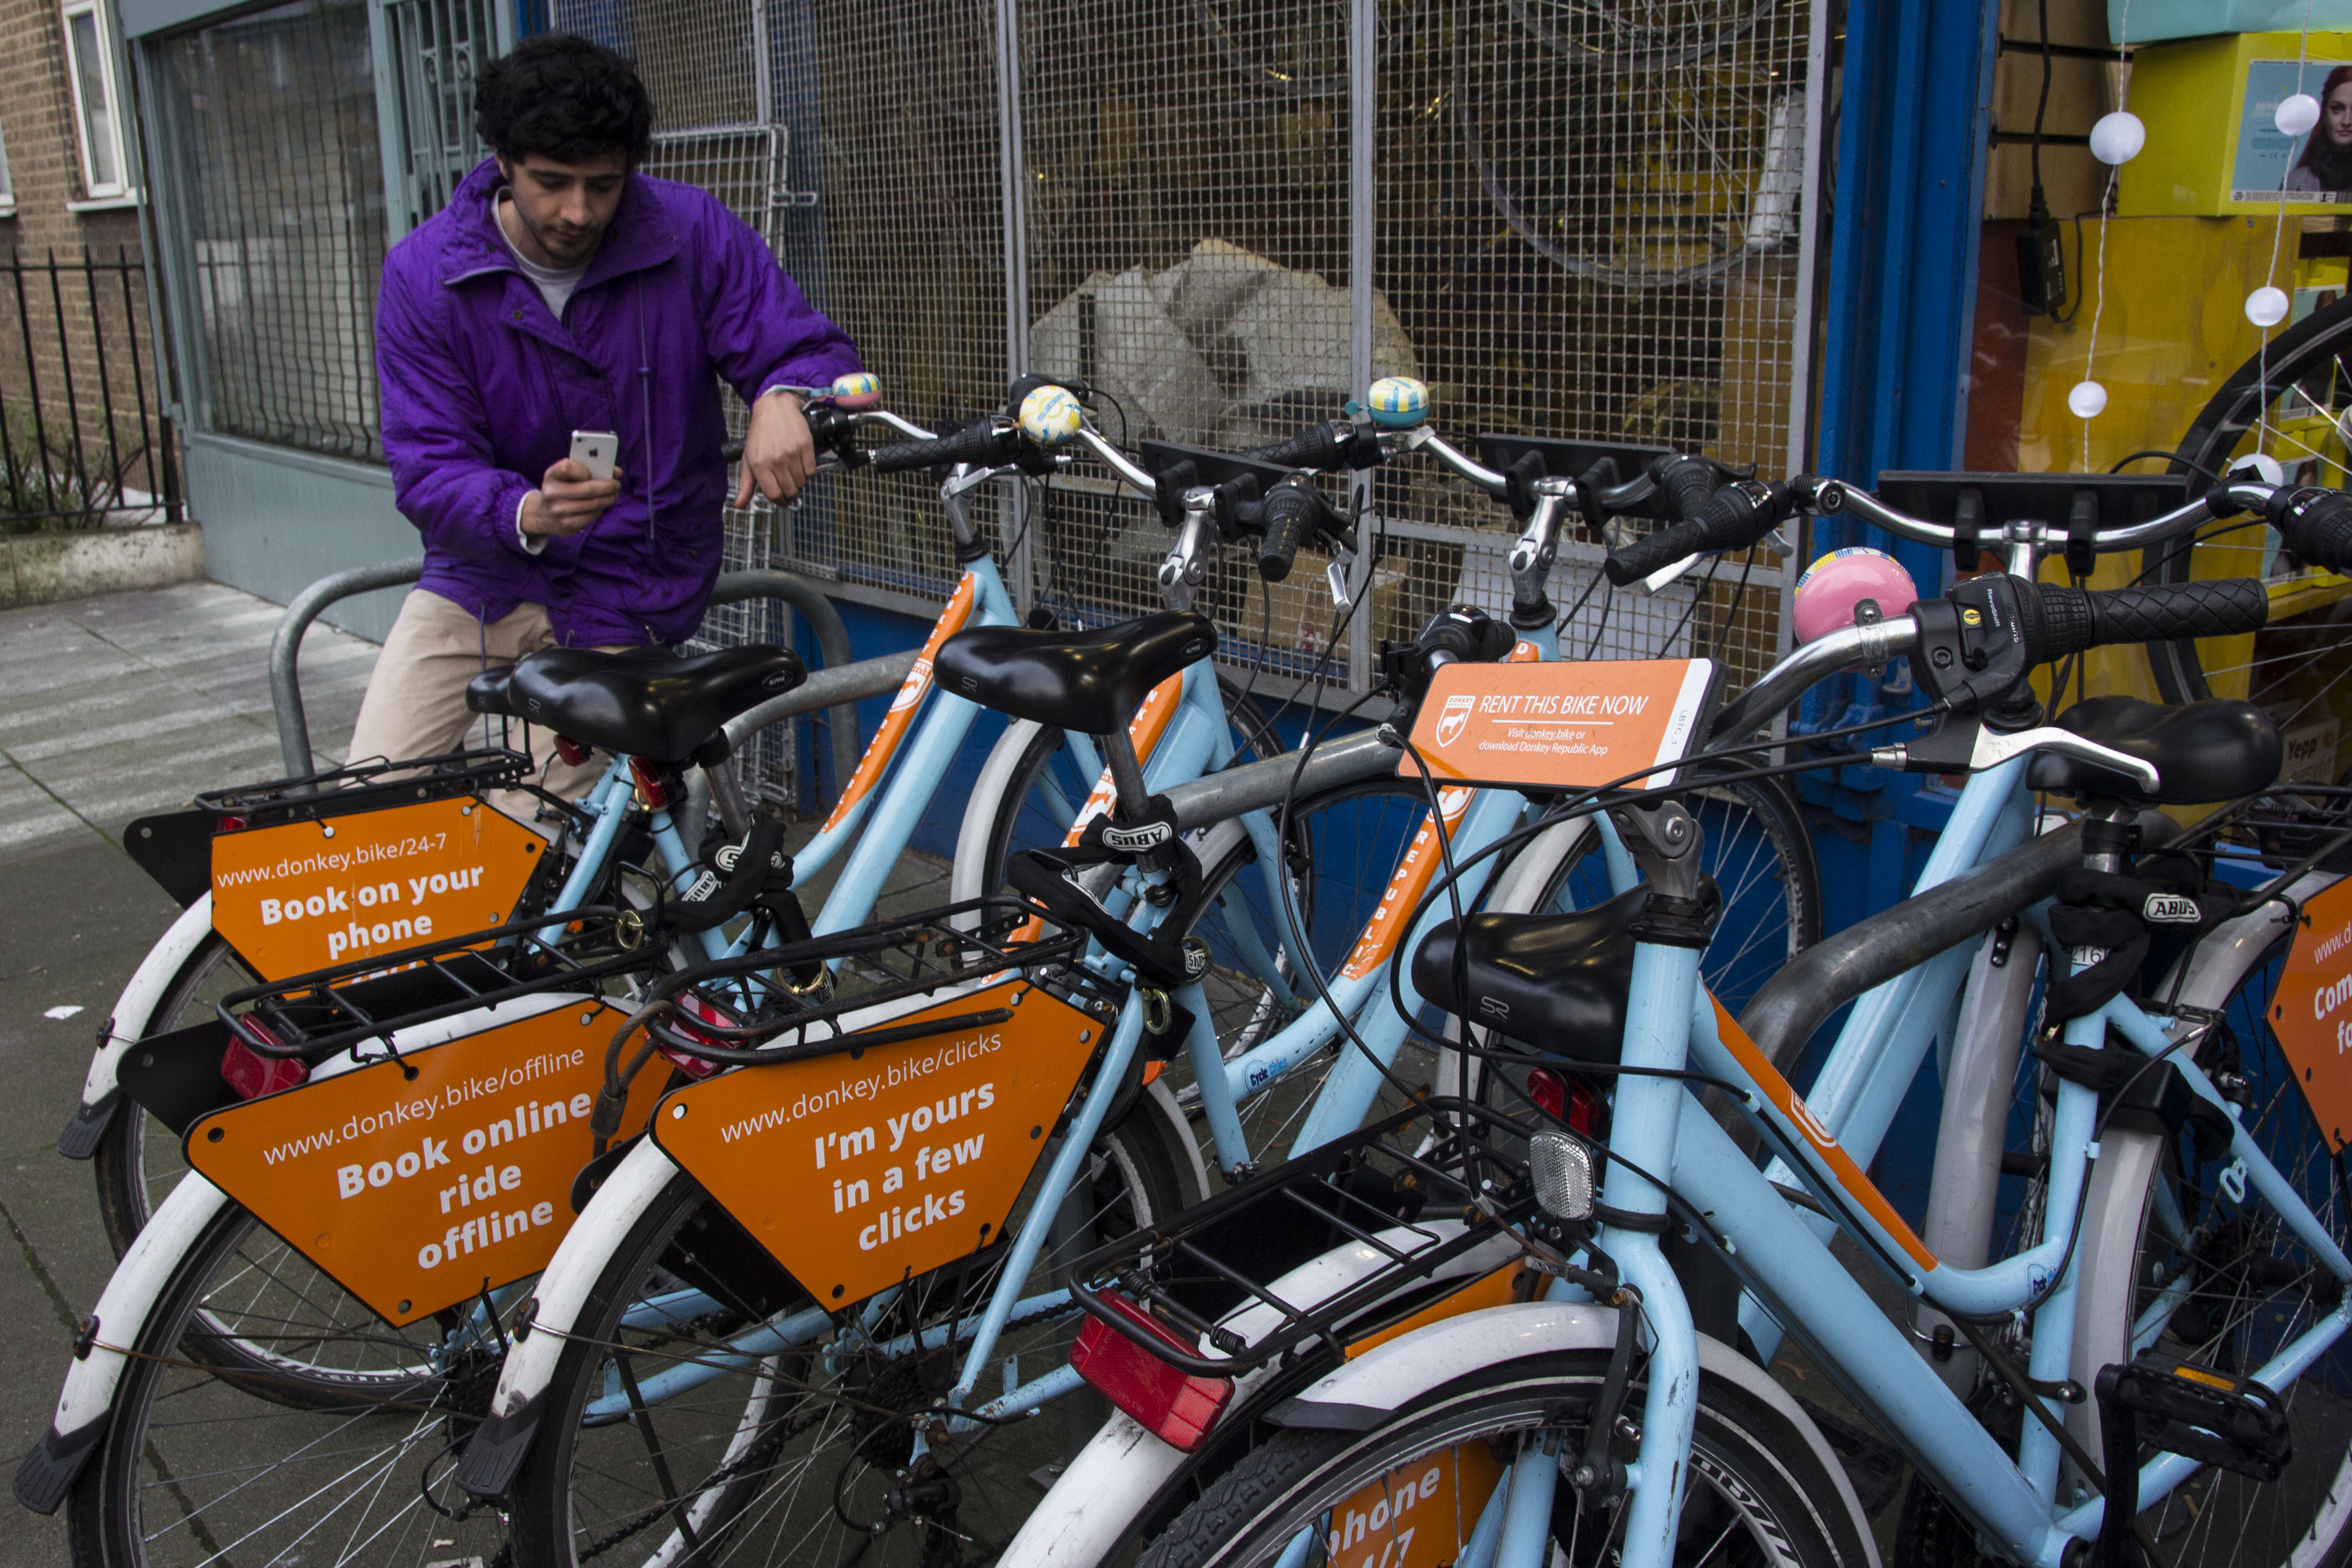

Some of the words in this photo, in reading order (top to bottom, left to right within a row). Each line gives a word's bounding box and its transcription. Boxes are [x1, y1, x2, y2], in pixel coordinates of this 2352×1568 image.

[1987, 588, 2001, 628] RevoShift
[1420, 614, 1440, 641] RevoShift
[1186, 644, 1200, 654] ALPINE
[962, 677, 977, 693] SR
[1479, 695, 1523, 713] RENT
[1523, 695, 1560, 714] THIS
[1560, 696, 1600, 715] BIKE
[1600, 696, 1650, 715] NOW
[1508, 727, 1523, 738] Visit
[1525, 728, 1575, 741] donkey.bike
[1576, 731, 1586, 740] or
[1670, 709, 1689, 745] LBTC_1
[1479, 740, 1519, 751] download
[1519, 741, 1551, 755] Donkey
[1551, 742, 1589, 755] Republic
[1589, 744, 1608, 756] App
[2288, 738, 2317, 760] Yepp
[1111, 828, 1163, 846] ABUS
[217, 833, 447, 888] www.donkey.bike/24-7
[260, 886, 348, 925] Book
[358, 882, 399, 906] on
[408, 866, 483, 906] your
[2154, 900, 2195, 915] ABUS
[328, 915, 432, 961] phone
[1480, 996, 1509, 1019] SR
[721, 1033, 1001, 1143] www.donkey.bike/clicks
[1250, 1068, 1269, 1087] Cycle
[263, 1048, 584, 1166] www.donkey.bike/offline
[887, 1083, 994, 1152] yours
[337, 1136, 450, 1199] Book
[462, 1093, 591, 1155] online
[440, 1164, 521, 1214] ride
[833, 1180, 869, 1213] in
[883, 1167, 903, 1194] a
[915, 1134, 985, 1181] few
[418, 1202, 552, 1269] offline
[859, 1190, 965, 1251] clicks
